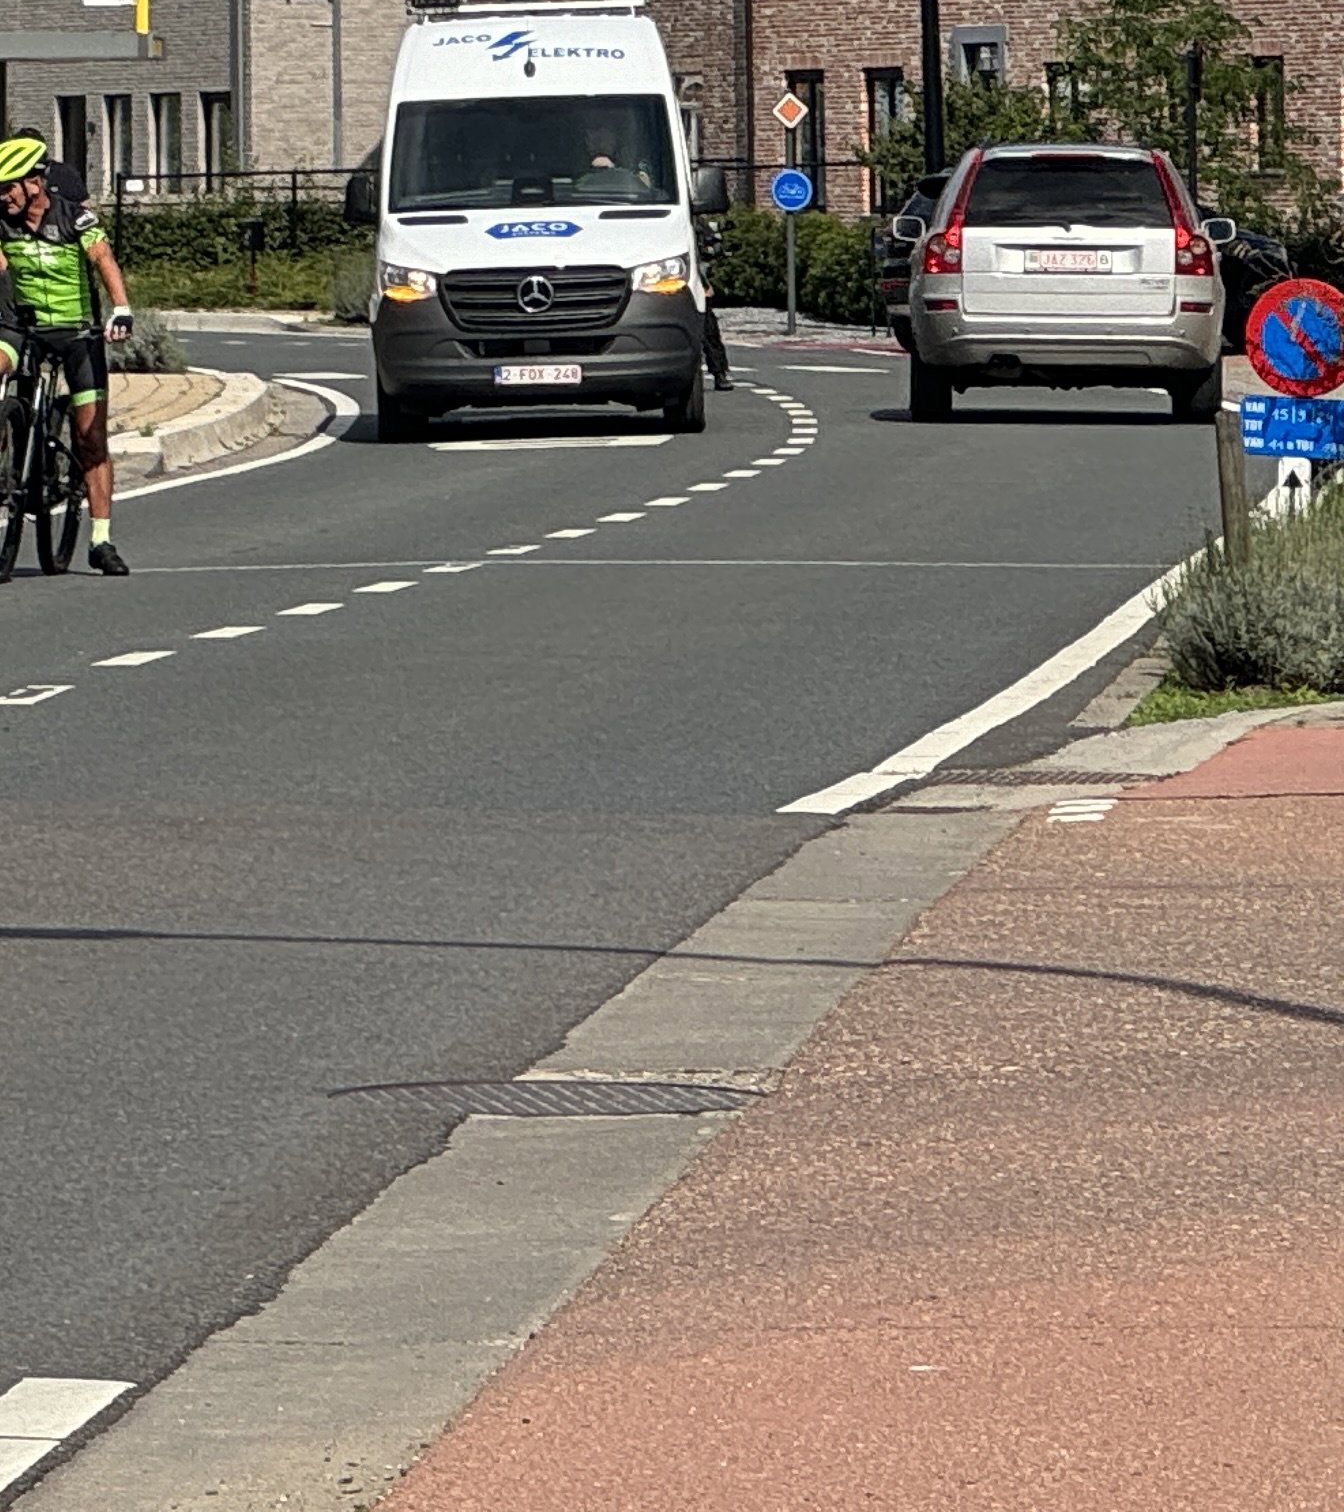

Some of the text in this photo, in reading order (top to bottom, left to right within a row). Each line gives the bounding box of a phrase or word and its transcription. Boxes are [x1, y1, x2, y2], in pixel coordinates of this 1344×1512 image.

[432, 34, 492, 47] JACO
[527, 48, 625, 60] ELEKTRO
[500, 223, 569, 234] JACO
